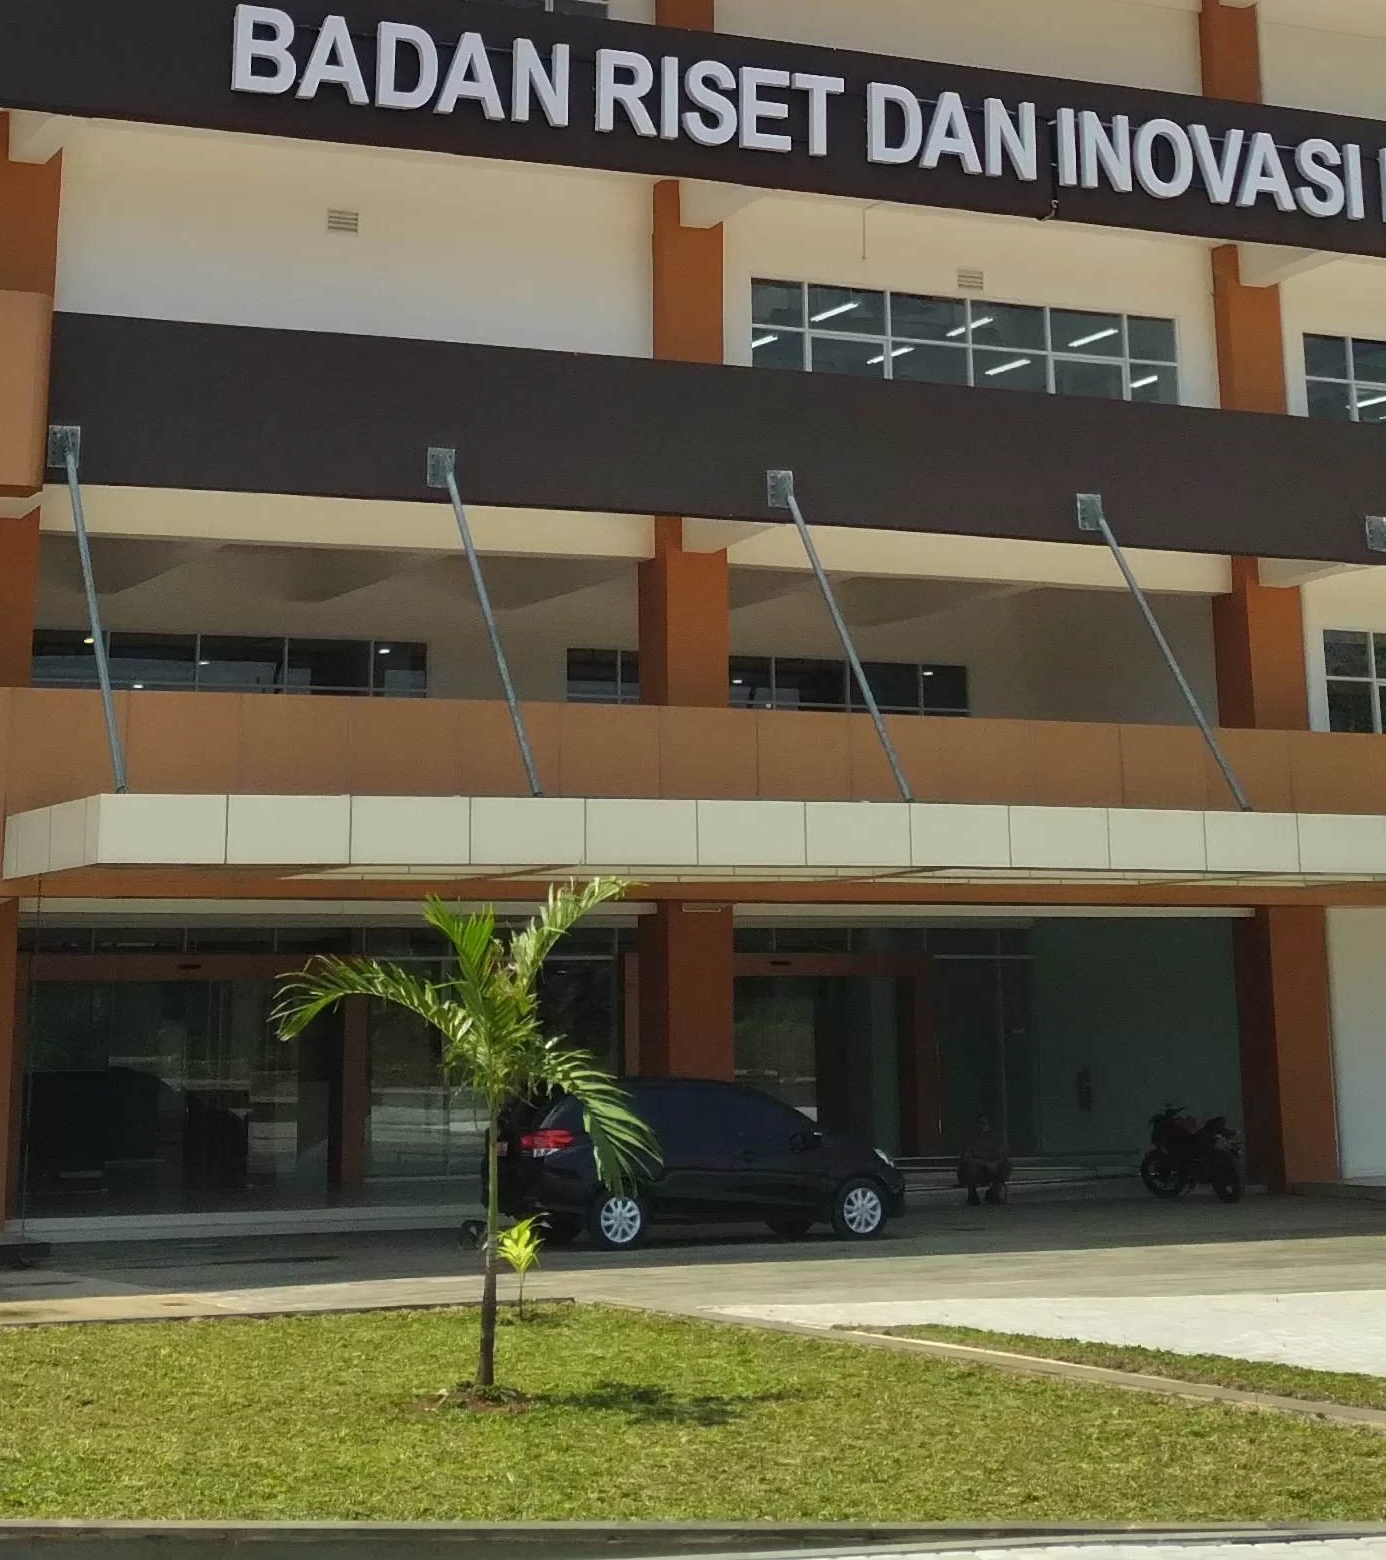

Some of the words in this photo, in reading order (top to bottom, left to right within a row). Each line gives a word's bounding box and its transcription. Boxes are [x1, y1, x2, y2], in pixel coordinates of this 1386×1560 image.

[231, 3, 569, 127] BADAN
[595, 48, 845, 156] RISET
[867, 82, 1036, 181] DAN
[1056, 108, 1365, 220] INOVASI
